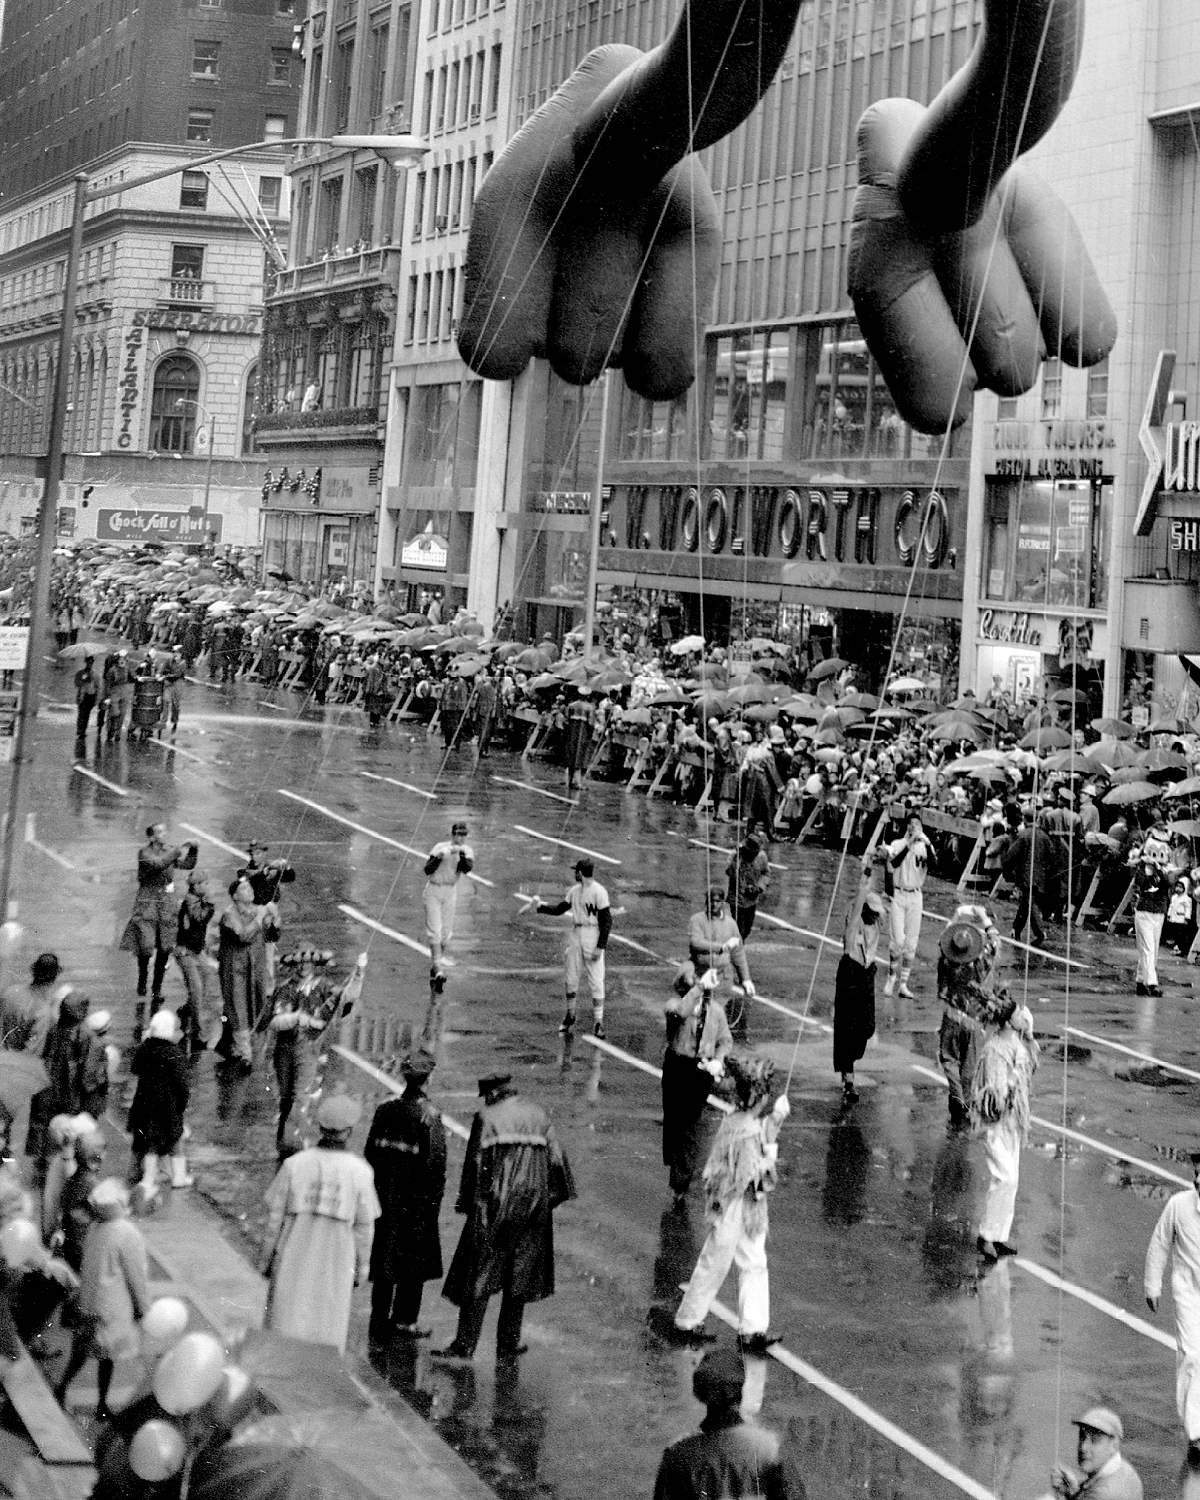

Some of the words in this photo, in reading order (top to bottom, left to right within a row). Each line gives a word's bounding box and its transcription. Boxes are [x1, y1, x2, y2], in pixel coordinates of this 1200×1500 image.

[132, 309, 259, 333] SHERATON
[659, 487, 881, 566] WOOLWORTH
[895, 489, 957, 570] CO.
[586, 902, 598, 917] W
